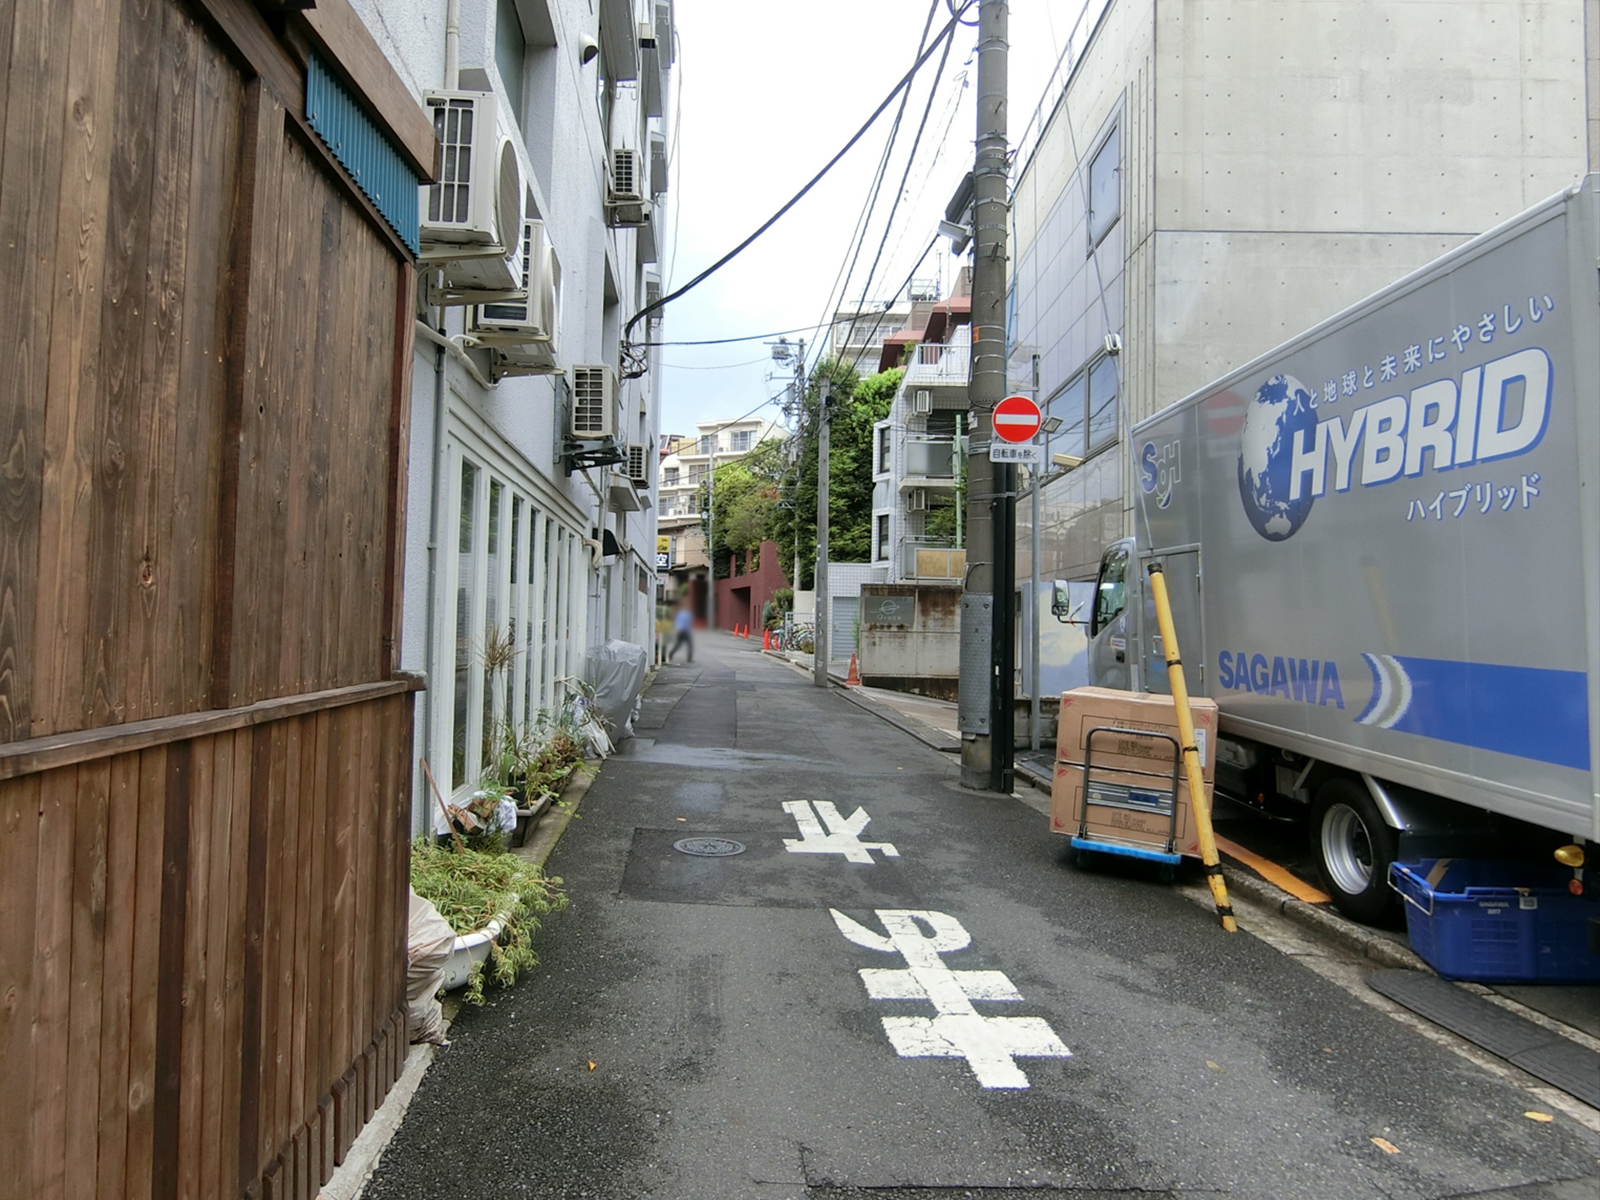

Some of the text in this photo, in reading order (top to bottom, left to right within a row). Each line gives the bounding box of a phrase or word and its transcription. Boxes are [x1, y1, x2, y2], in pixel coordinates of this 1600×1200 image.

[1293, 293, 1555, 417] 人と地球と未来にやさしい
[1289, 346, 1554, 501] HYBRID
[992, 448, 1038, 461] 自転車を除く
[1406, 472, 1541, 521] ハイブリッド
[1218, 650, 1346, 710] SAGAWA
